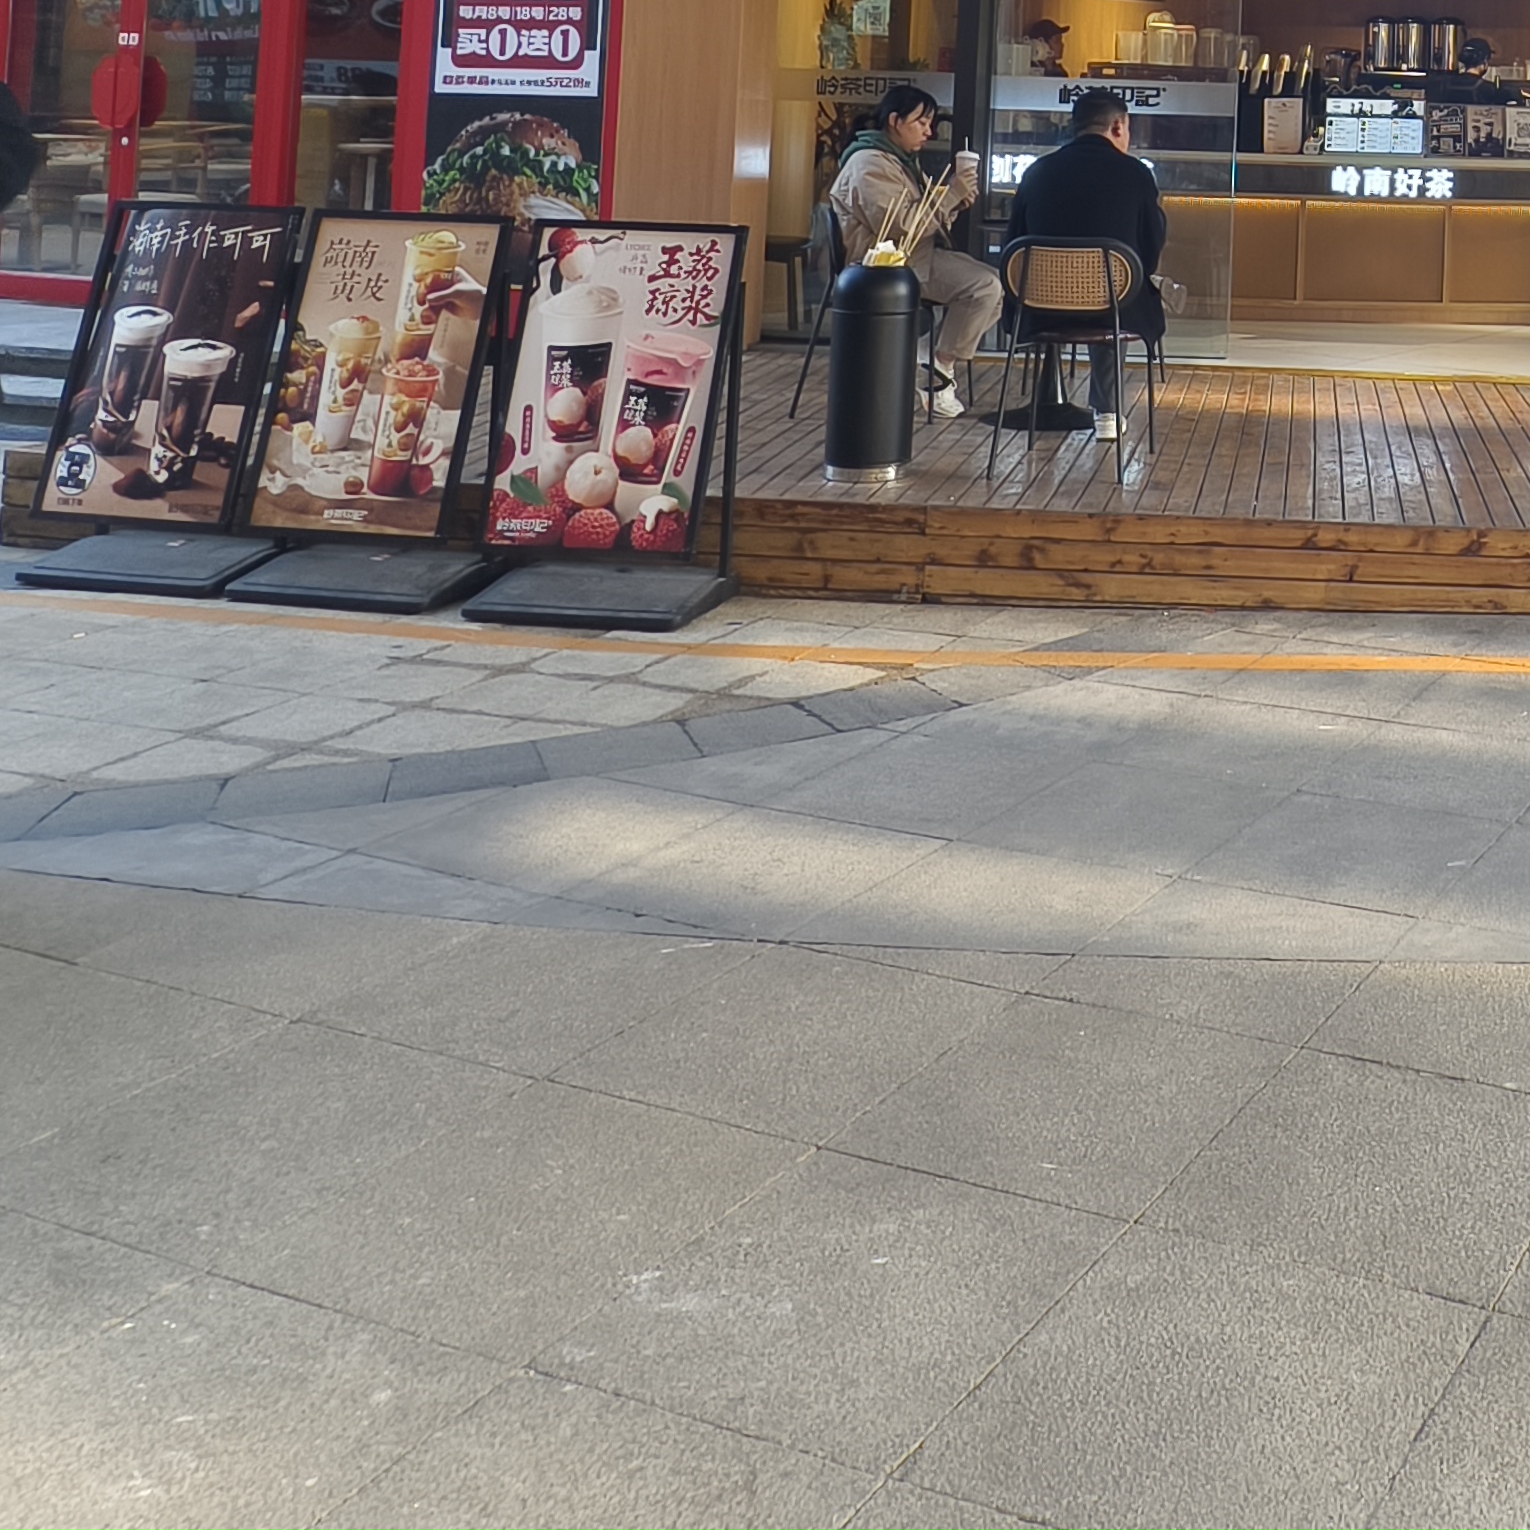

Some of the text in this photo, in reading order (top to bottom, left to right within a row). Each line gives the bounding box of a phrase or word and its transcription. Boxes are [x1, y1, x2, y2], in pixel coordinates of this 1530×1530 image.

[1059, 84, 1161, 107] 岭印記
[1331, 165, 1454, 198] 岭南好茶
